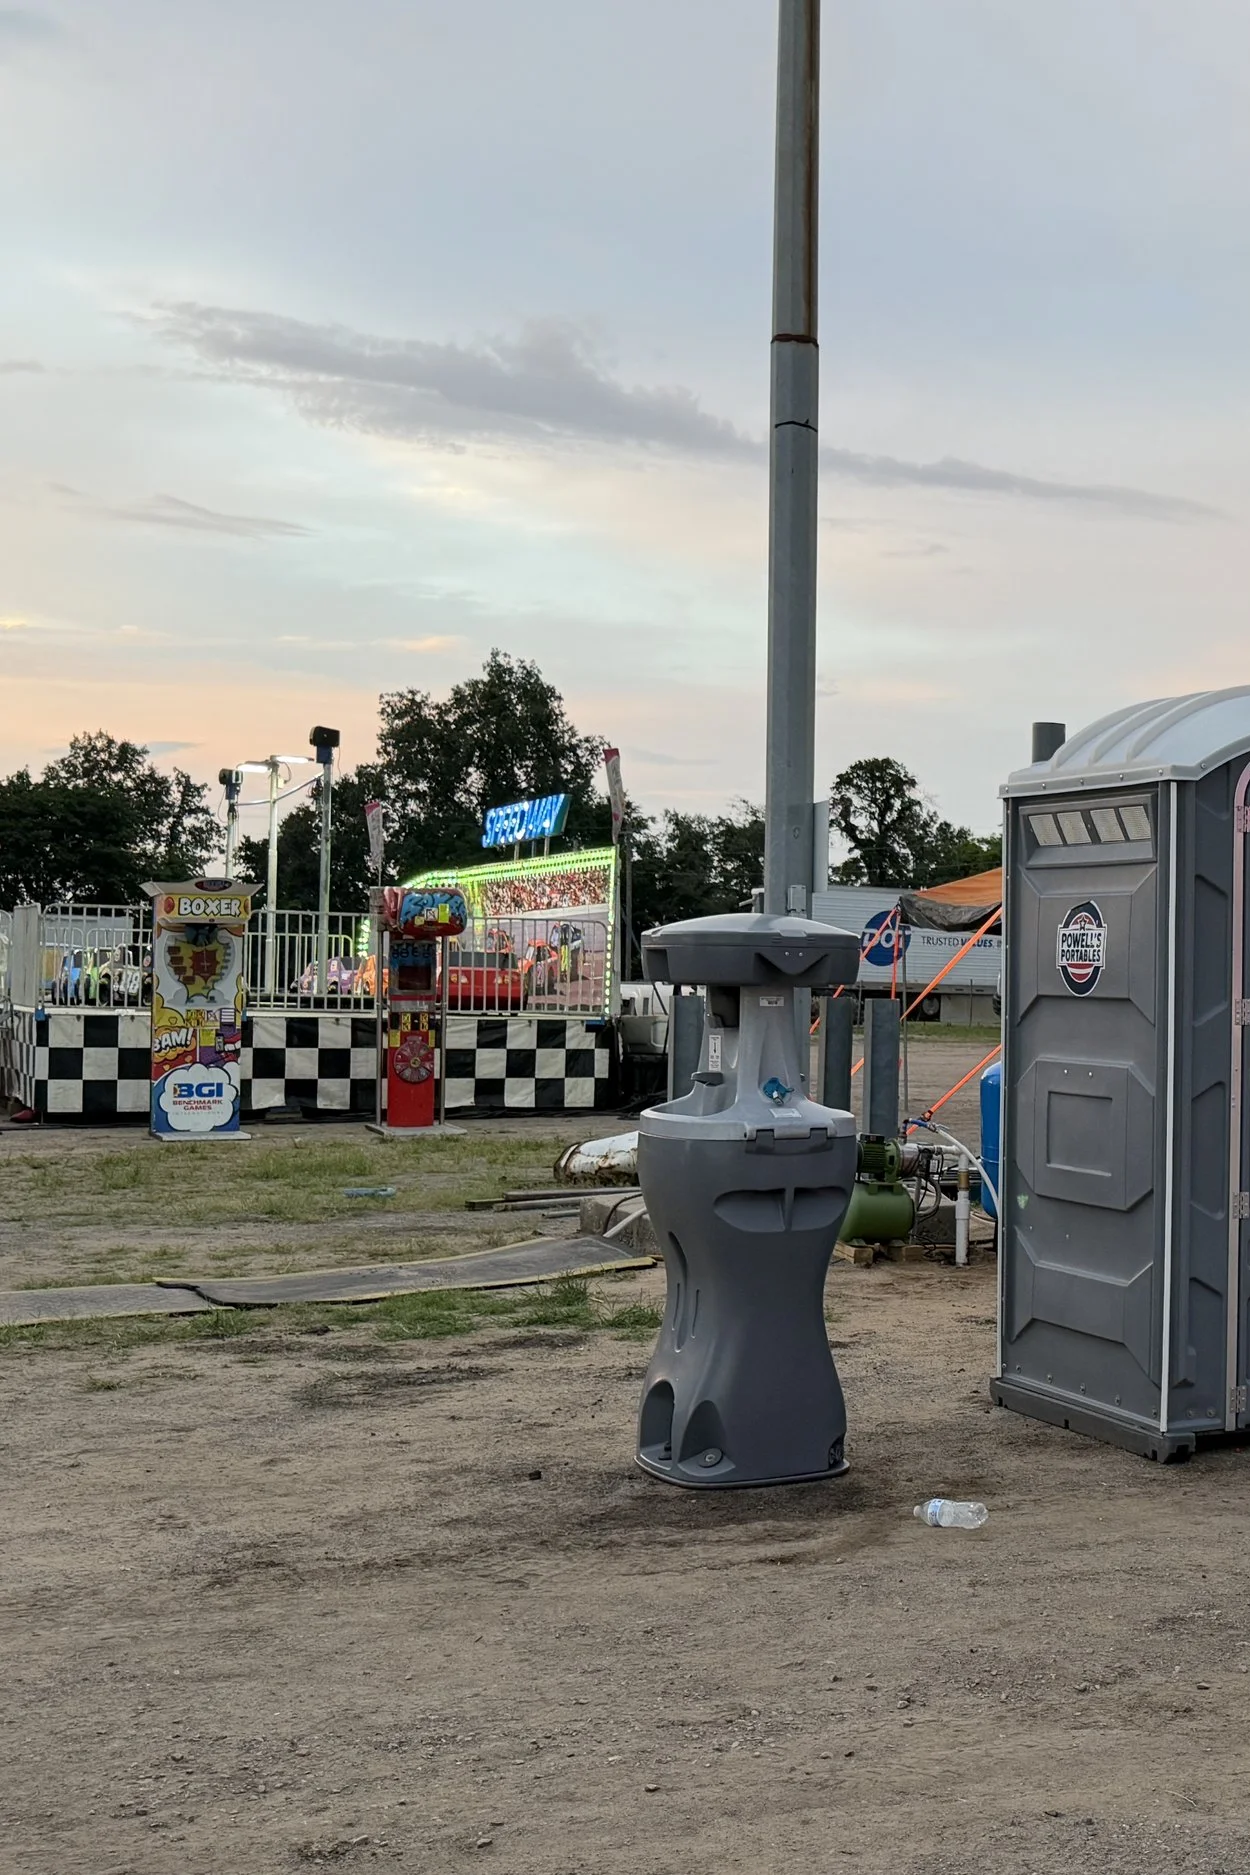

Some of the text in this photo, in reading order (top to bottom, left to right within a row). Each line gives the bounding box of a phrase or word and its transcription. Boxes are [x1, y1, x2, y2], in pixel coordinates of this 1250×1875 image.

[482, 793, 565, 848] SPEEDWAY
[179, 897, 241, 917] BOXER
[861, 928, 911, 949] DOT
[921, 935, 960, 947] TRUSTED
[1060, 949, 1102, 962] PORTABLES
[173, 1083, 224, 1098] BGI
